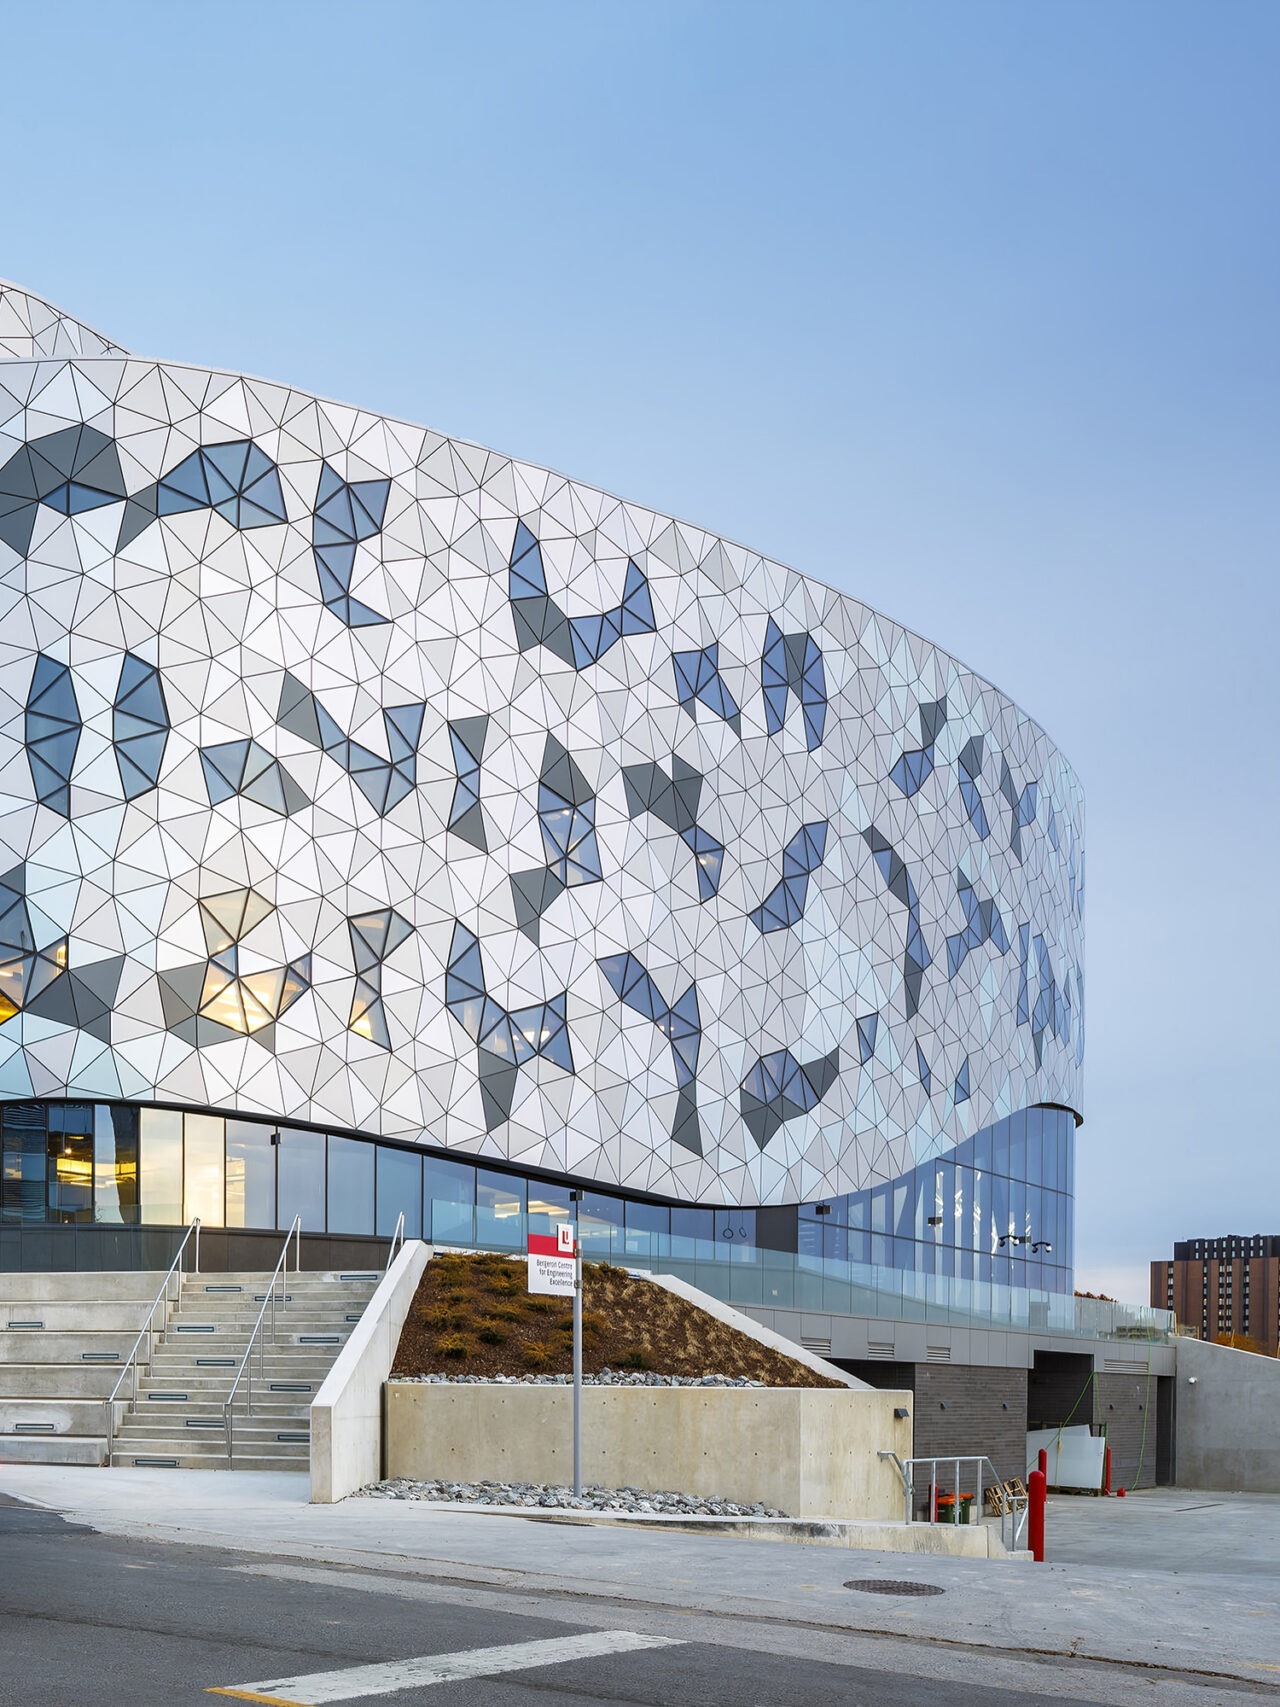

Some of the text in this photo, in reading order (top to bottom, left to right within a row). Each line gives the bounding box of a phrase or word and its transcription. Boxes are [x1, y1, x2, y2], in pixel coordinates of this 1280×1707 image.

[537, 1259, 572, 1270] Bergeron Centre
[547, 1269, 572, 1279] Engineering
[550, 1278, 572, 1287] Excellence
